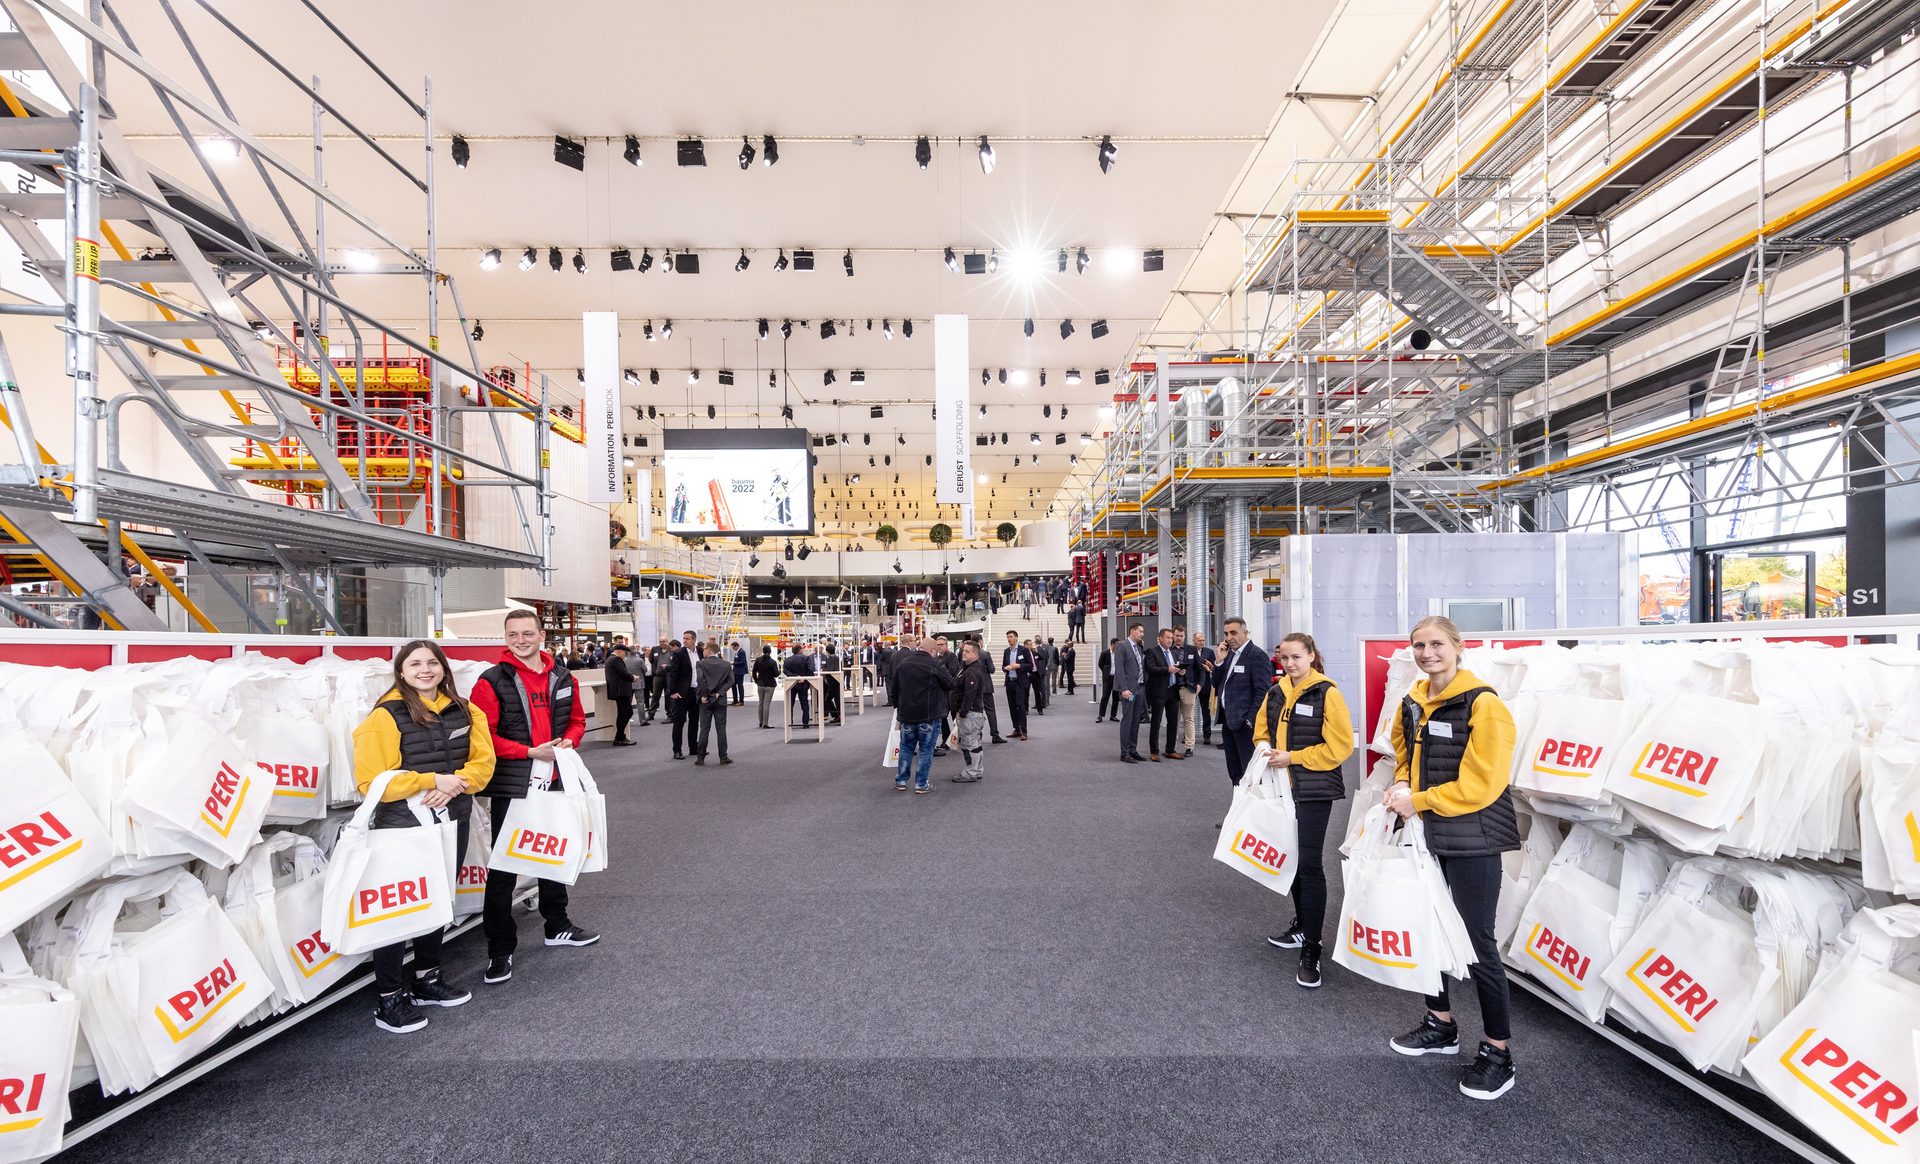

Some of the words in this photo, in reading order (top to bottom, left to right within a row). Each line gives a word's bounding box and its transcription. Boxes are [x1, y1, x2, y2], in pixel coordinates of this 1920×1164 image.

[90, 245, 98, 259] UP
[90, 258, 98, 273] PERI
[606, 387, 614, 430] PERIBOOK
[956, 400, 964, 456] SCAFFOLDING
[608, 433, 616, 493] INFORMATION
[731, 484, 755, 493] 2022
[1852, 587, 1879, 605] S1
[1540, 738, 1603, 769] PERI
[1646, 742, 1719, 786] PERI
[204, 761, 241, 822] PERI
[518, 829, 568, 857] PERI
[1241, 833, 1287, 868] PERI
[359, 876, 429, 915] PERI
[1353, 920, 1412, 957] PERI
[1535, 927, 1591, 981] PERI
[168, 958, 237, 1021] PERI
[1643, 955, 1718, 1023] PERI
[1801, 1038, 1919, 1135] PERI
